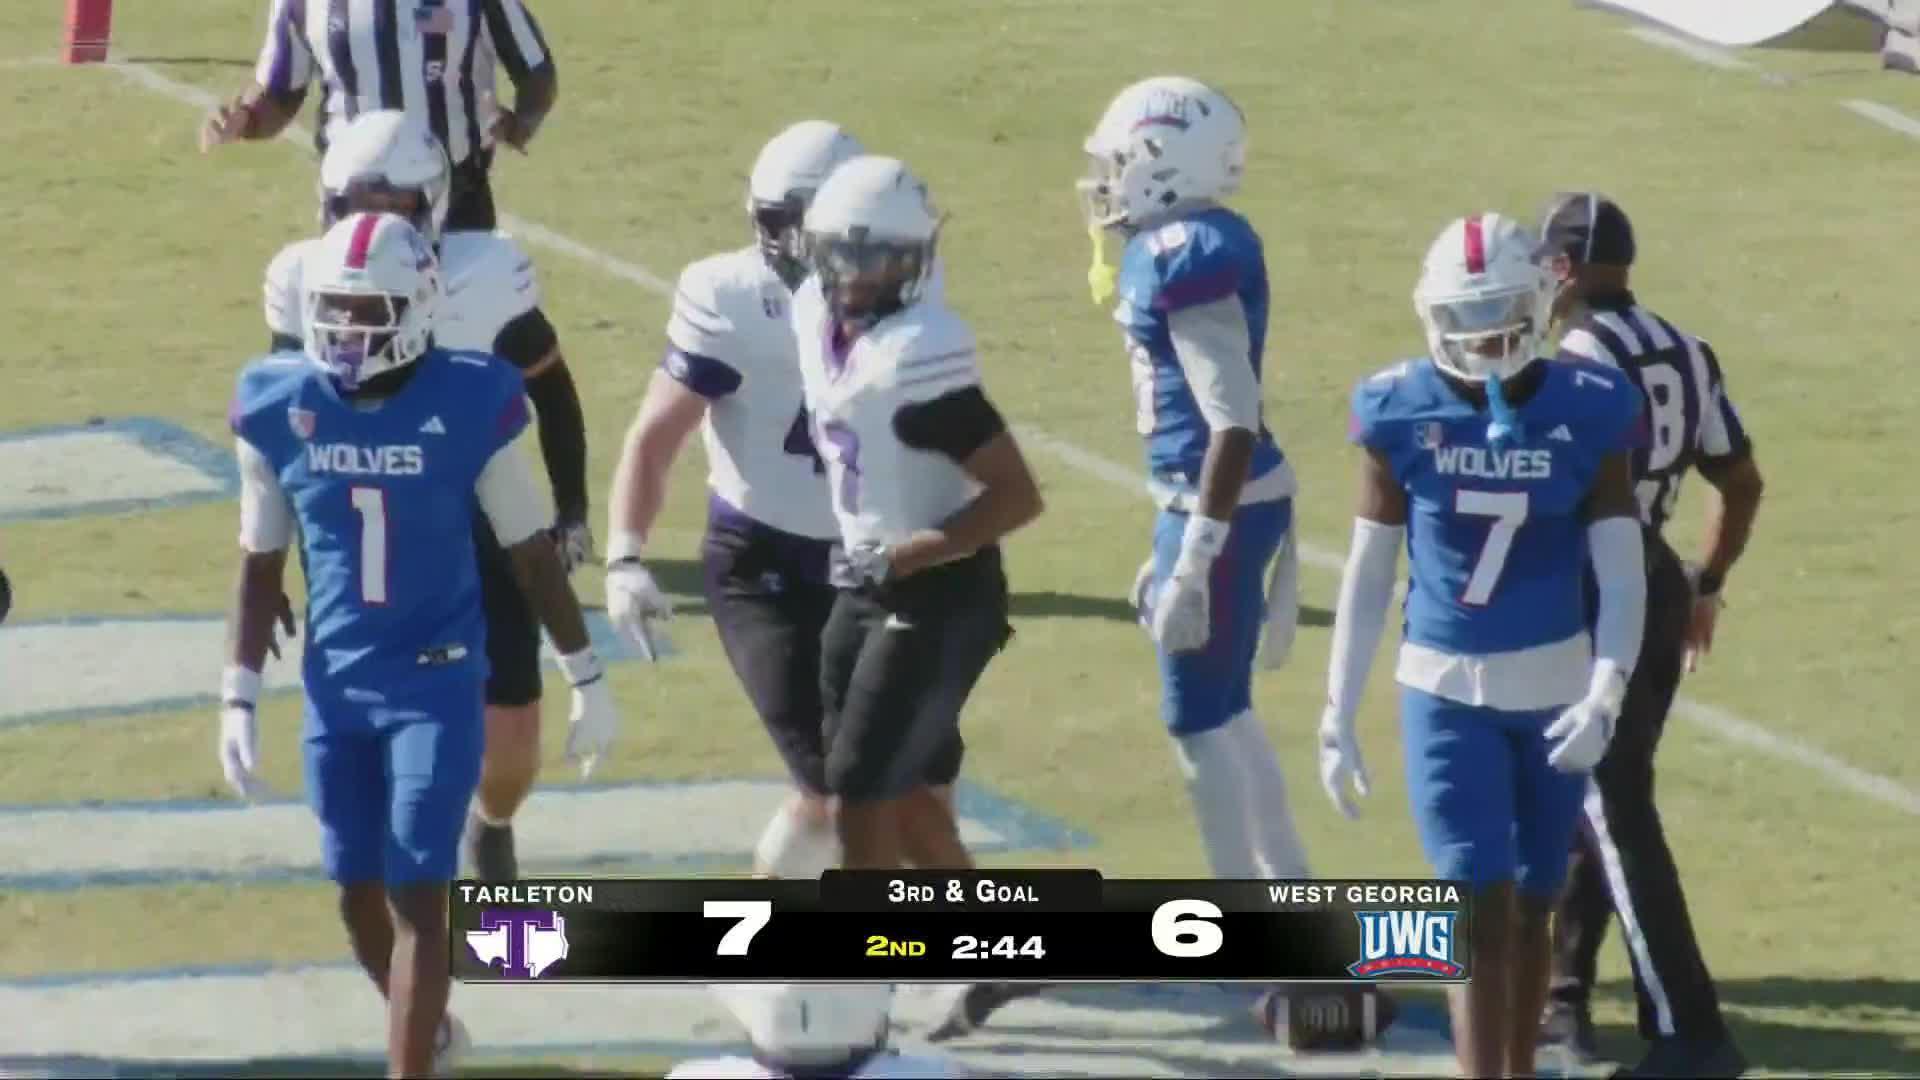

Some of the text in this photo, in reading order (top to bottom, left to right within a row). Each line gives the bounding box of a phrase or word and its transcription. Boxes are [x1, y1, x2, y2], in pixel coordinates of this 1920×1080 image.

[308, 442, 423, 475] WOLVES
[1434, 446, 1553, 479] WOLVES
[349, 485, 389, 606] 1
[1454, 487, 1530, 607] 7
